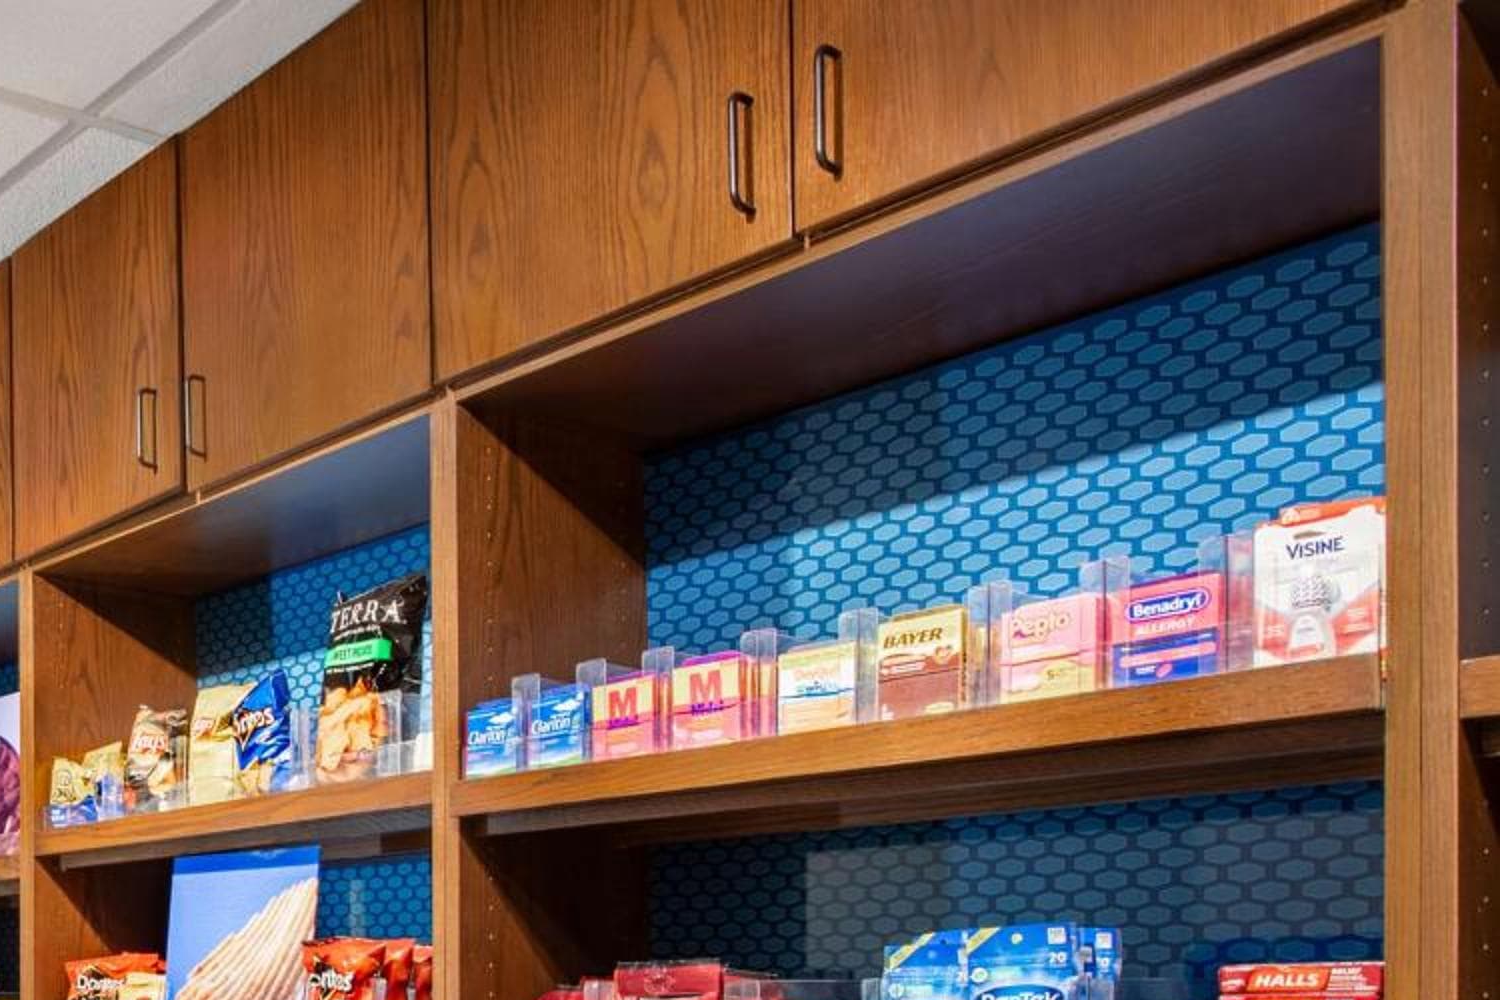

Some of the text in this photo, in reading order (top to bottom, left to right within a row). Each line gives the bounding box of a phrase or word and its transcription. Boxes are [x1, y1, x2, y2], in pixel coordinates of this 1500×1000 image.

[1285, 536, 1344, 560] VISINE
[1133, 592, 1202, 619] Benadryl
[883, 626, 943, 649] BAYER
[689, 670, 722, 707] M
[608, 687, 637, 718] M
[1255, 973, 1319, 988] HALLS
